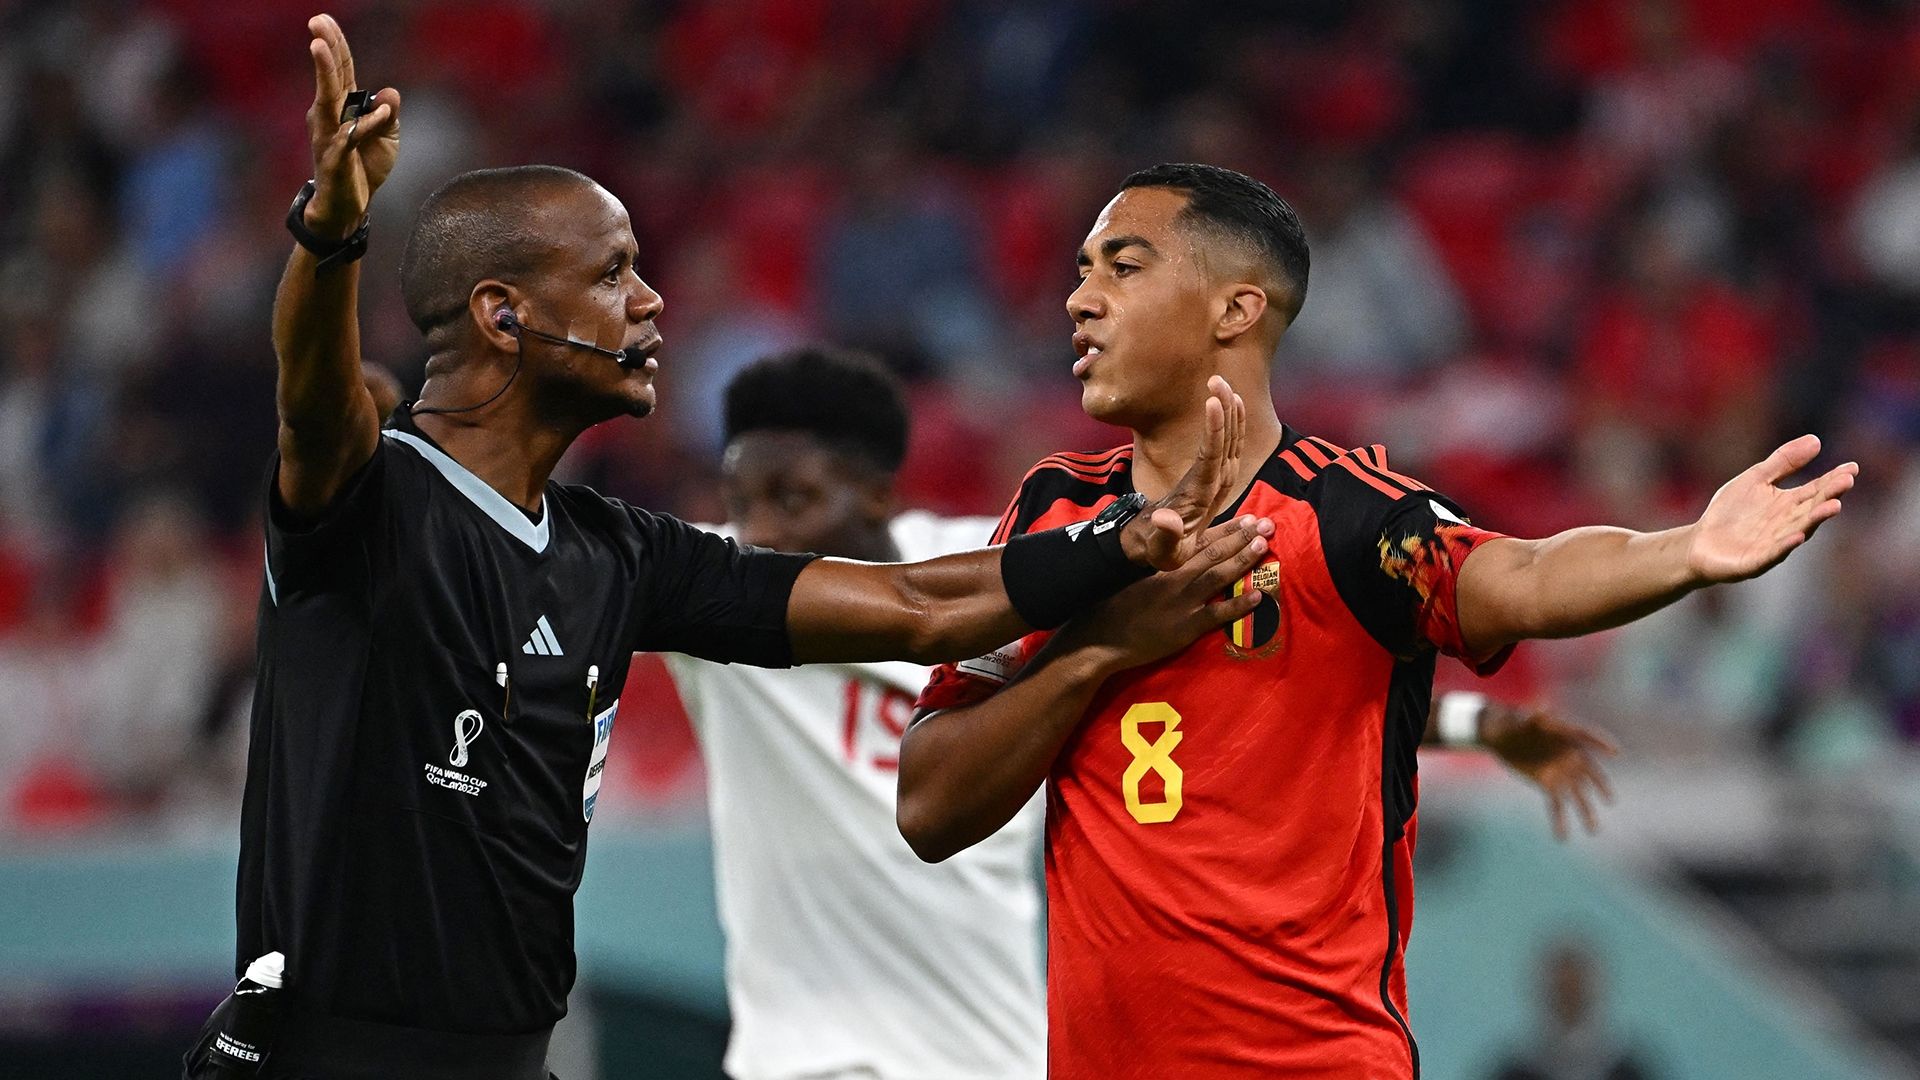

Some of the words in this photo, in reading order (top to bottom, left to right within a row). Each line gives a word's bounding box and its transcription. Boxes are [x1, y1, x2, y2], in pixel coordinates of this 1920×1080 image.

[424, 763, 443, 777] FIFA
[444, 769, 470, 783] WORLD
[469, 777, 488, 789] CUP
[1120, 701, 1184, 825] 8
[215, 1036, 260, 1062] EFEREES
